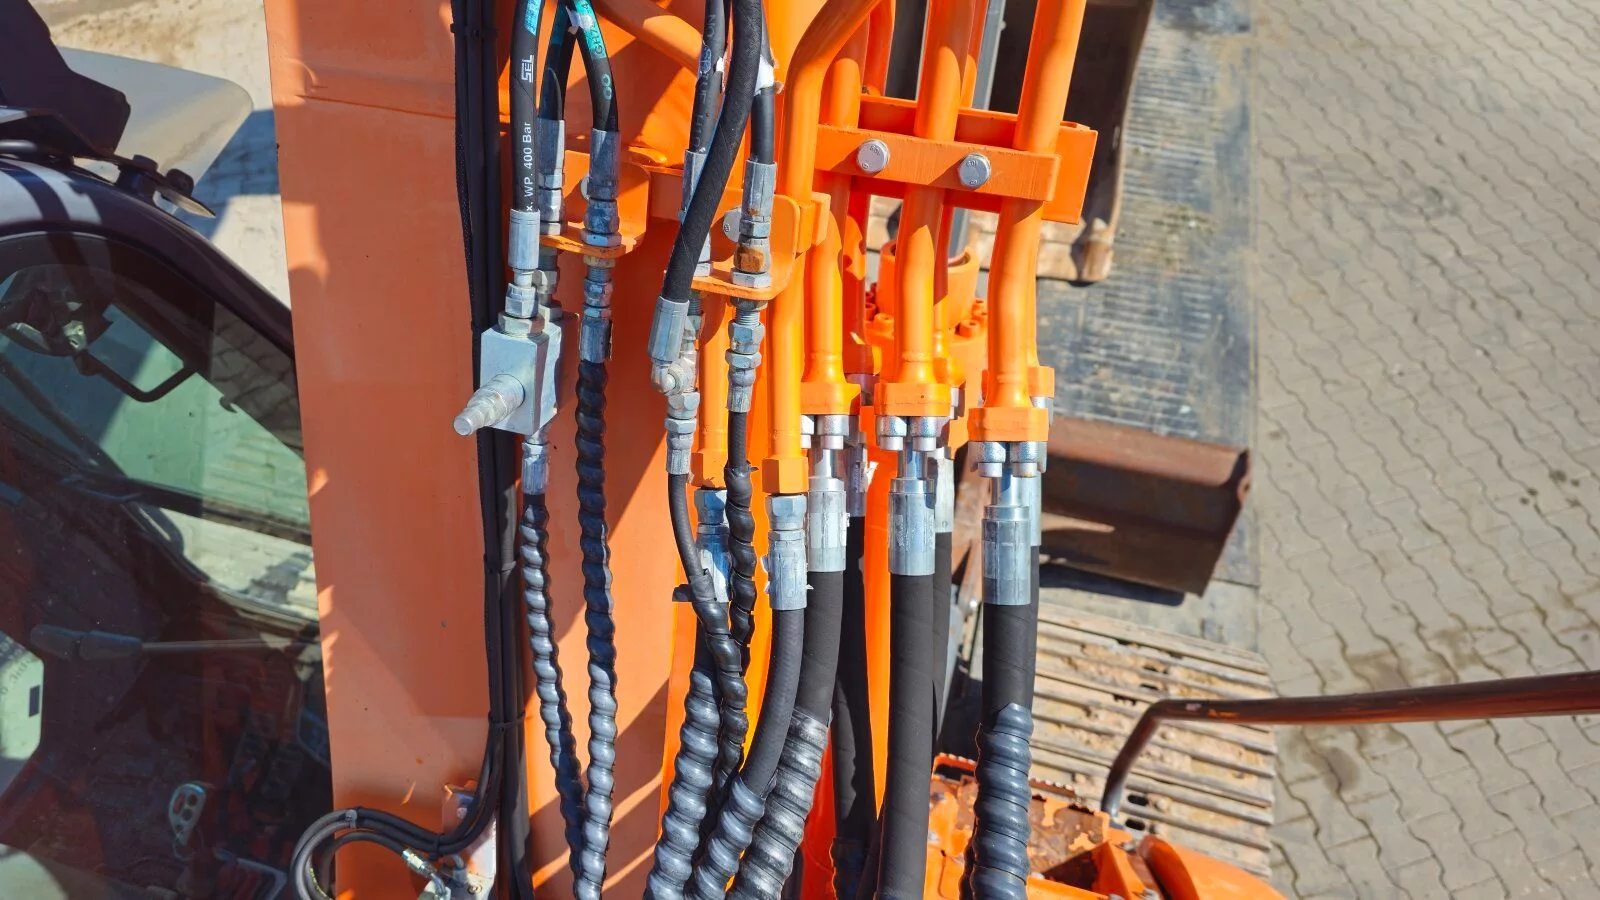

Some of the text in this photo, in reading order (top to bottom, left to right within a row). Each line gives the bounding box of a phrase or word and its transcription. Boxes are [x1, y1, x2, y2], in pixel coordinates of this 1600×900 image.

[520, 54, 535, 84] SEL
[522, 121, 532, 143] Bar
[523, 147, 533, 169] 400
